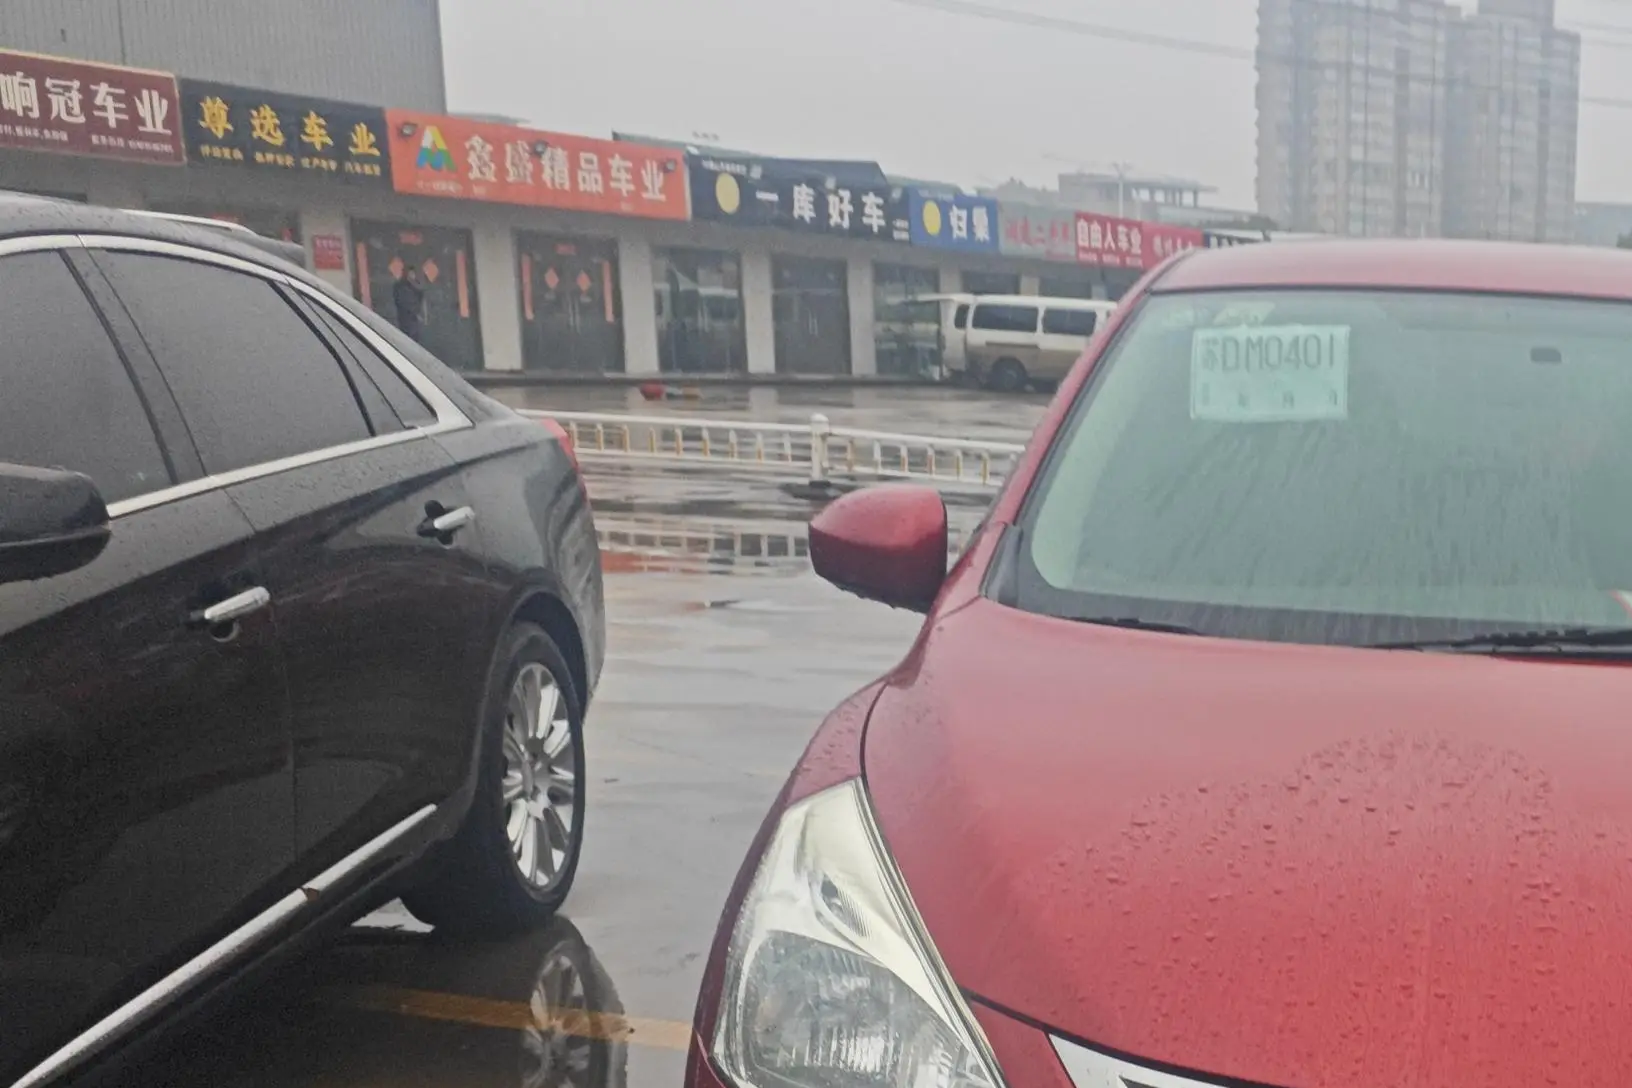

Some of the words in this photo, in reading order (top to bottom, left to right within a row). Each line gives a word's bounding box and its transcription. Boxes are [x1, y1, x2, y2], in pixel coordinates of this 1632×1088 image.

[198, 96, 381, 157] 尊选车业
[756, 183, 887, 233] 一库好车
